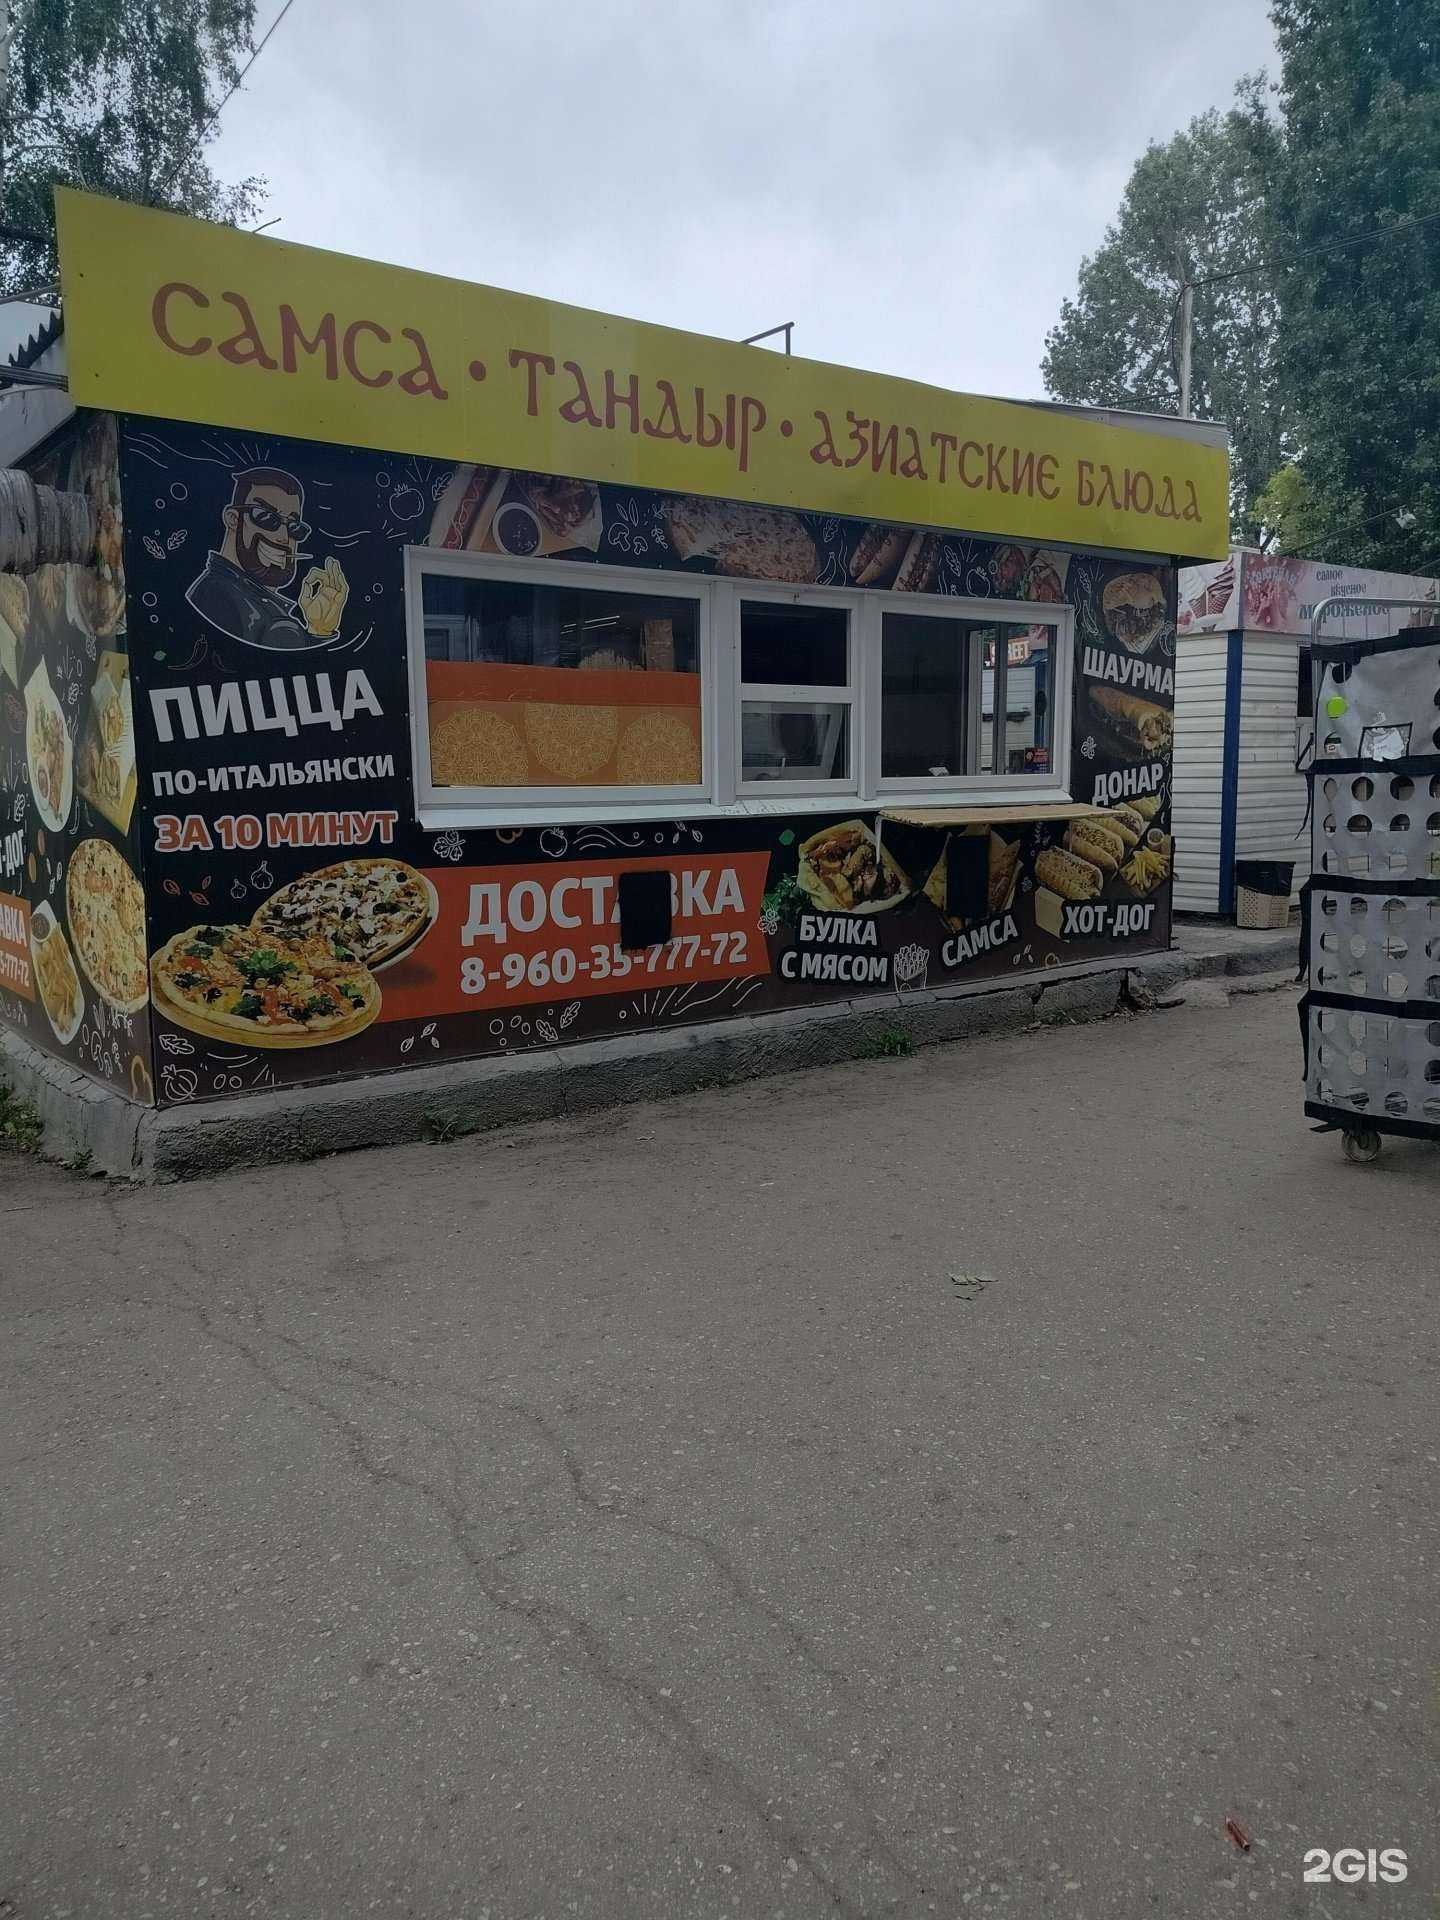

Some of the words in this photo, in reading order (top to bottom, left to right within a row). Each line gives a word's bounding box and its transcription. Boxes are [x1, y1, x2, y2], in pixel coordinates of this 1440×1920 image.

[152, 282, 449, 400] САМСА
[508, 349, 767, 472] ТАНДЫР
[809, 410, 1060, 500] АЗИАТСКИЕ
[1077, 459, 1202, 522] БЛЮДА
[1083, 646, 1174, 696] ШАУРМА
[149, 669, 384, 742] ПИЦЦА
[152, 754, 395, 797] ПО-ИТАЛЬЯНСКИ
[1091, 763, 1164, 807] ДОНАР
[153, 814, 213, 852] ЗА
[214, 814, 262, 850] 10
[266, 811, 399, 849] МИНУТ
[461, 868, 745, 946] ДОСТКА
[1063, 903, 1155, 937] ХОТ-ДОГ
[799, 914, 878, 946] БУЛКА
[941, 913, 1019, 968] САМСА
[781, 951, 796, 979] С
[801, 951, 888, 983] МЯСОМ
